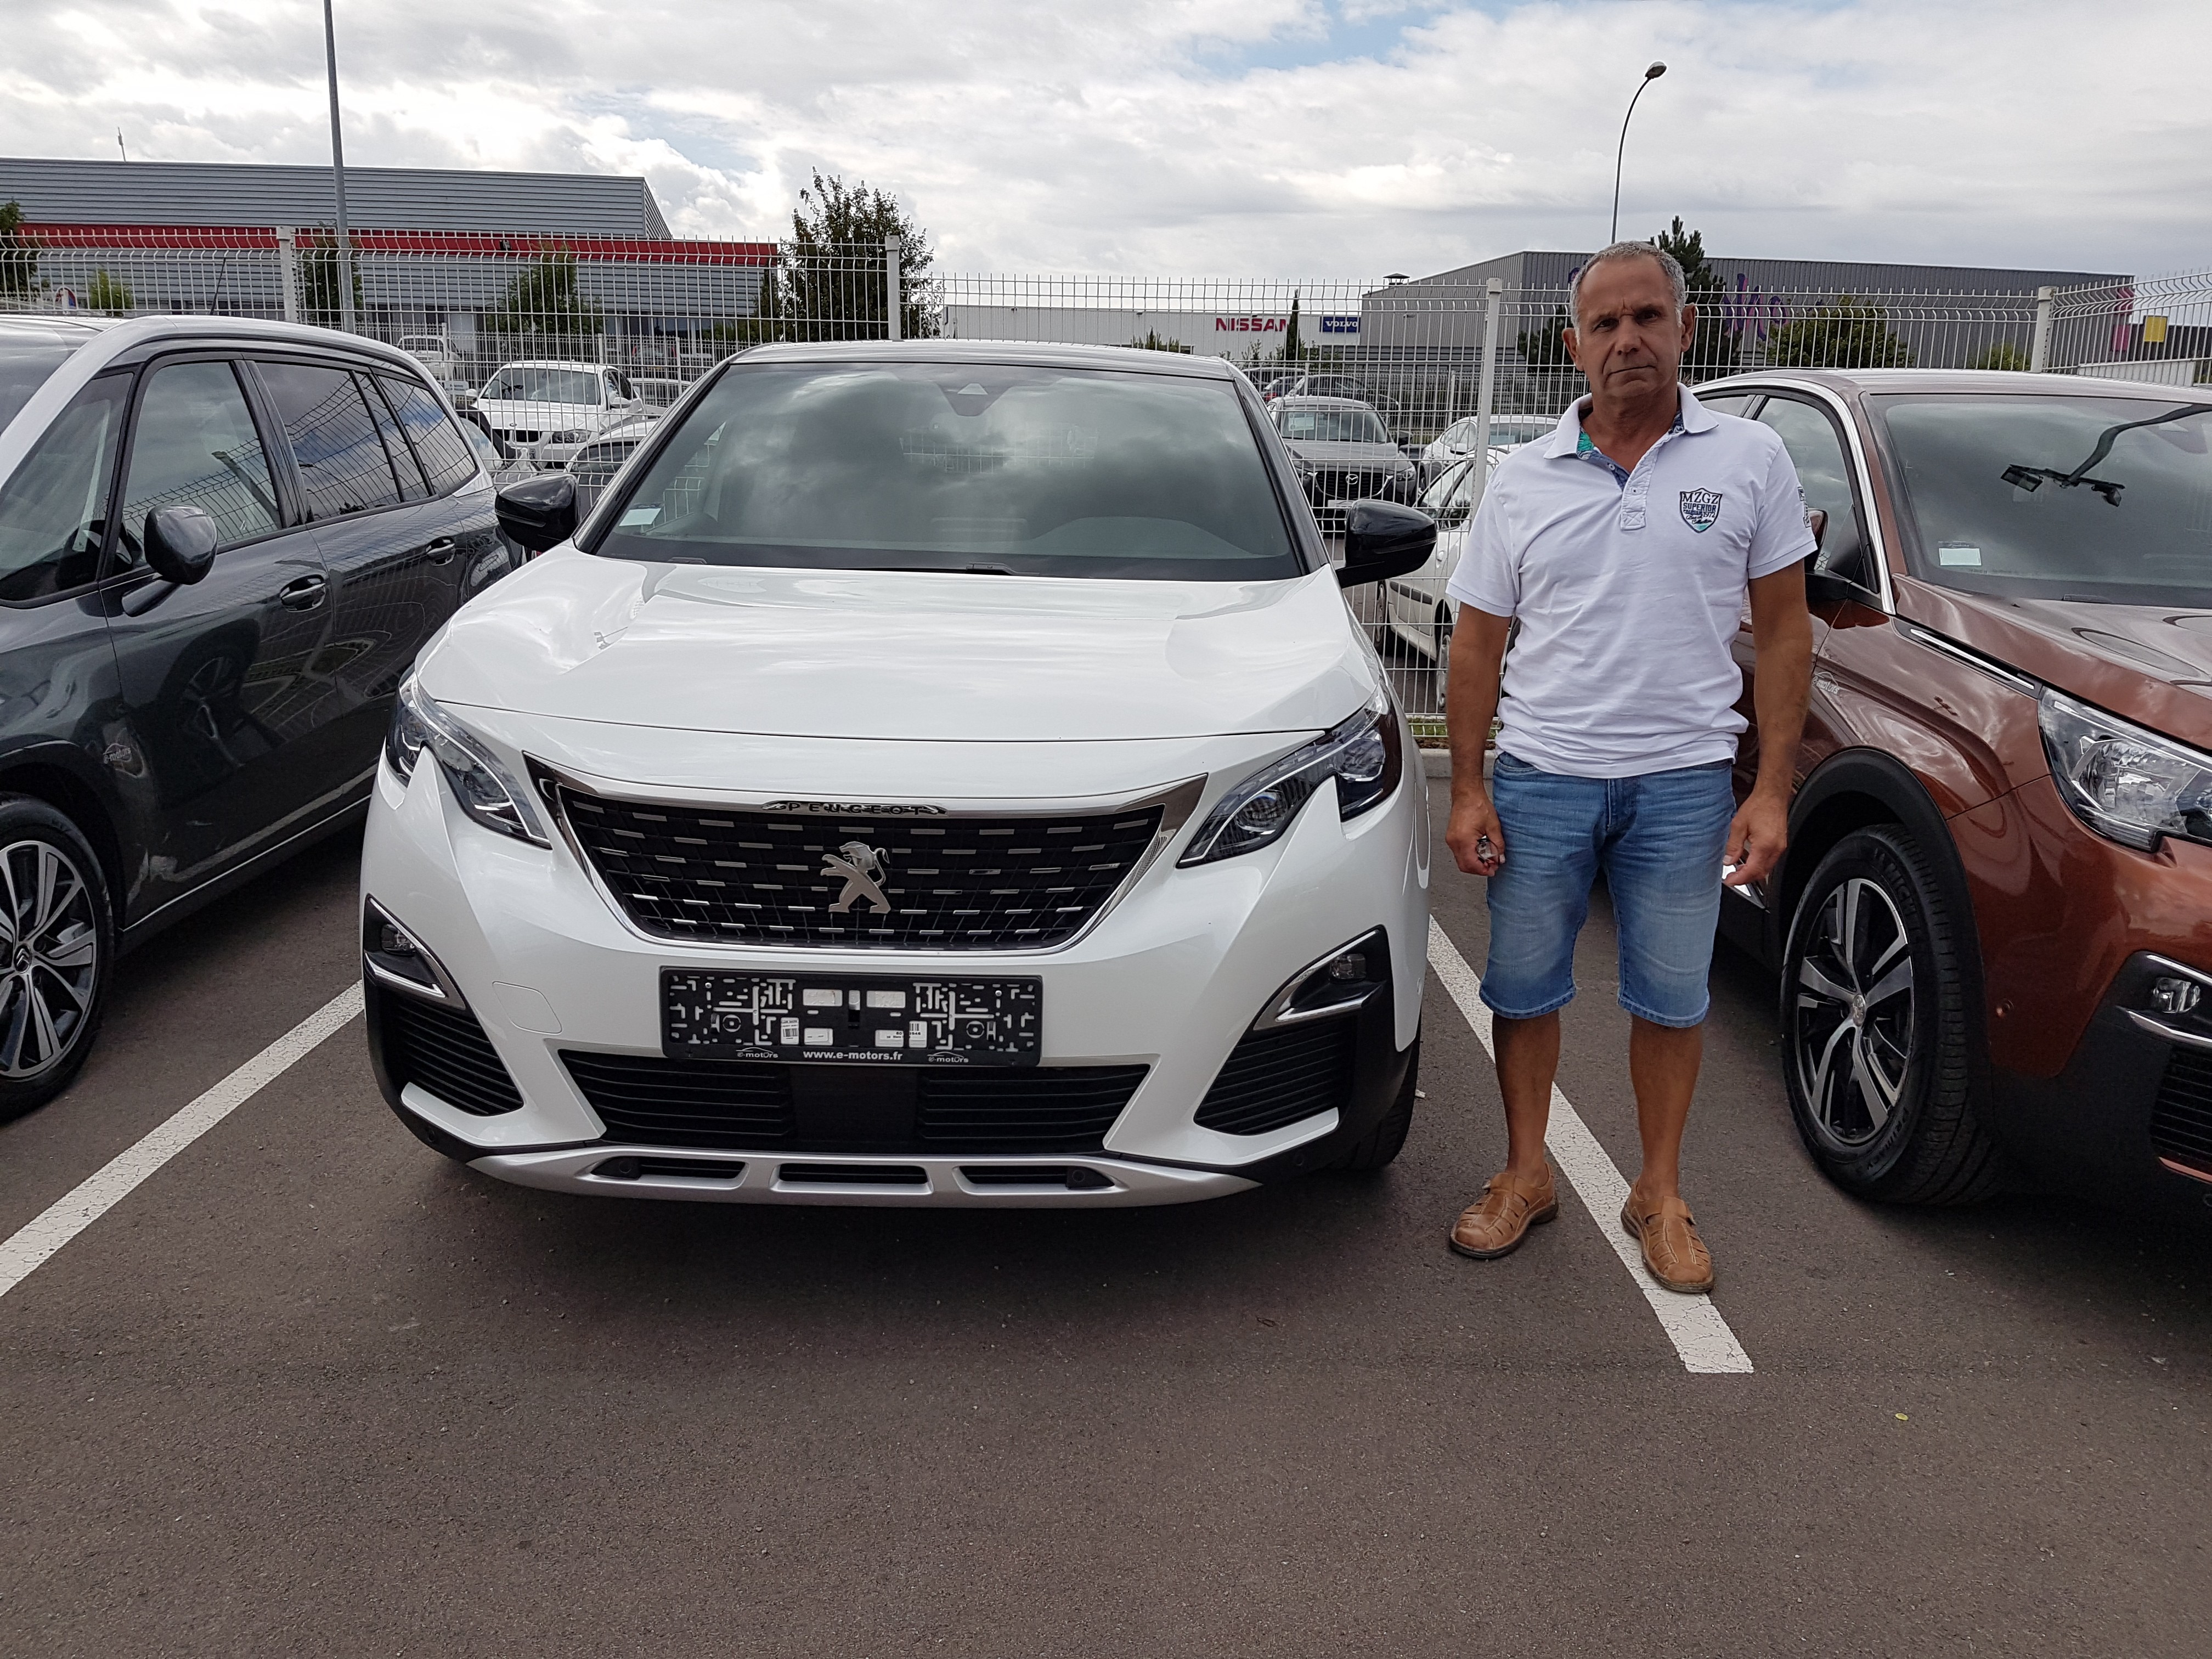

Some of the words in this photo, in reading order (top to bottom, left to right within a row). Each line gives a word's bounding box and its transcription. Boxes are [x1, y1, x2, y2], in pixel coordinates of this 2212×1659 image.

[1681, 492, 1719, 504] MZGZ
[1683, 503, 1717, 512] SUPERIOR
[788, 803, 924, 816] PEUGEOT
[803, 1051, 903, 1060] www.e-motors.fr
